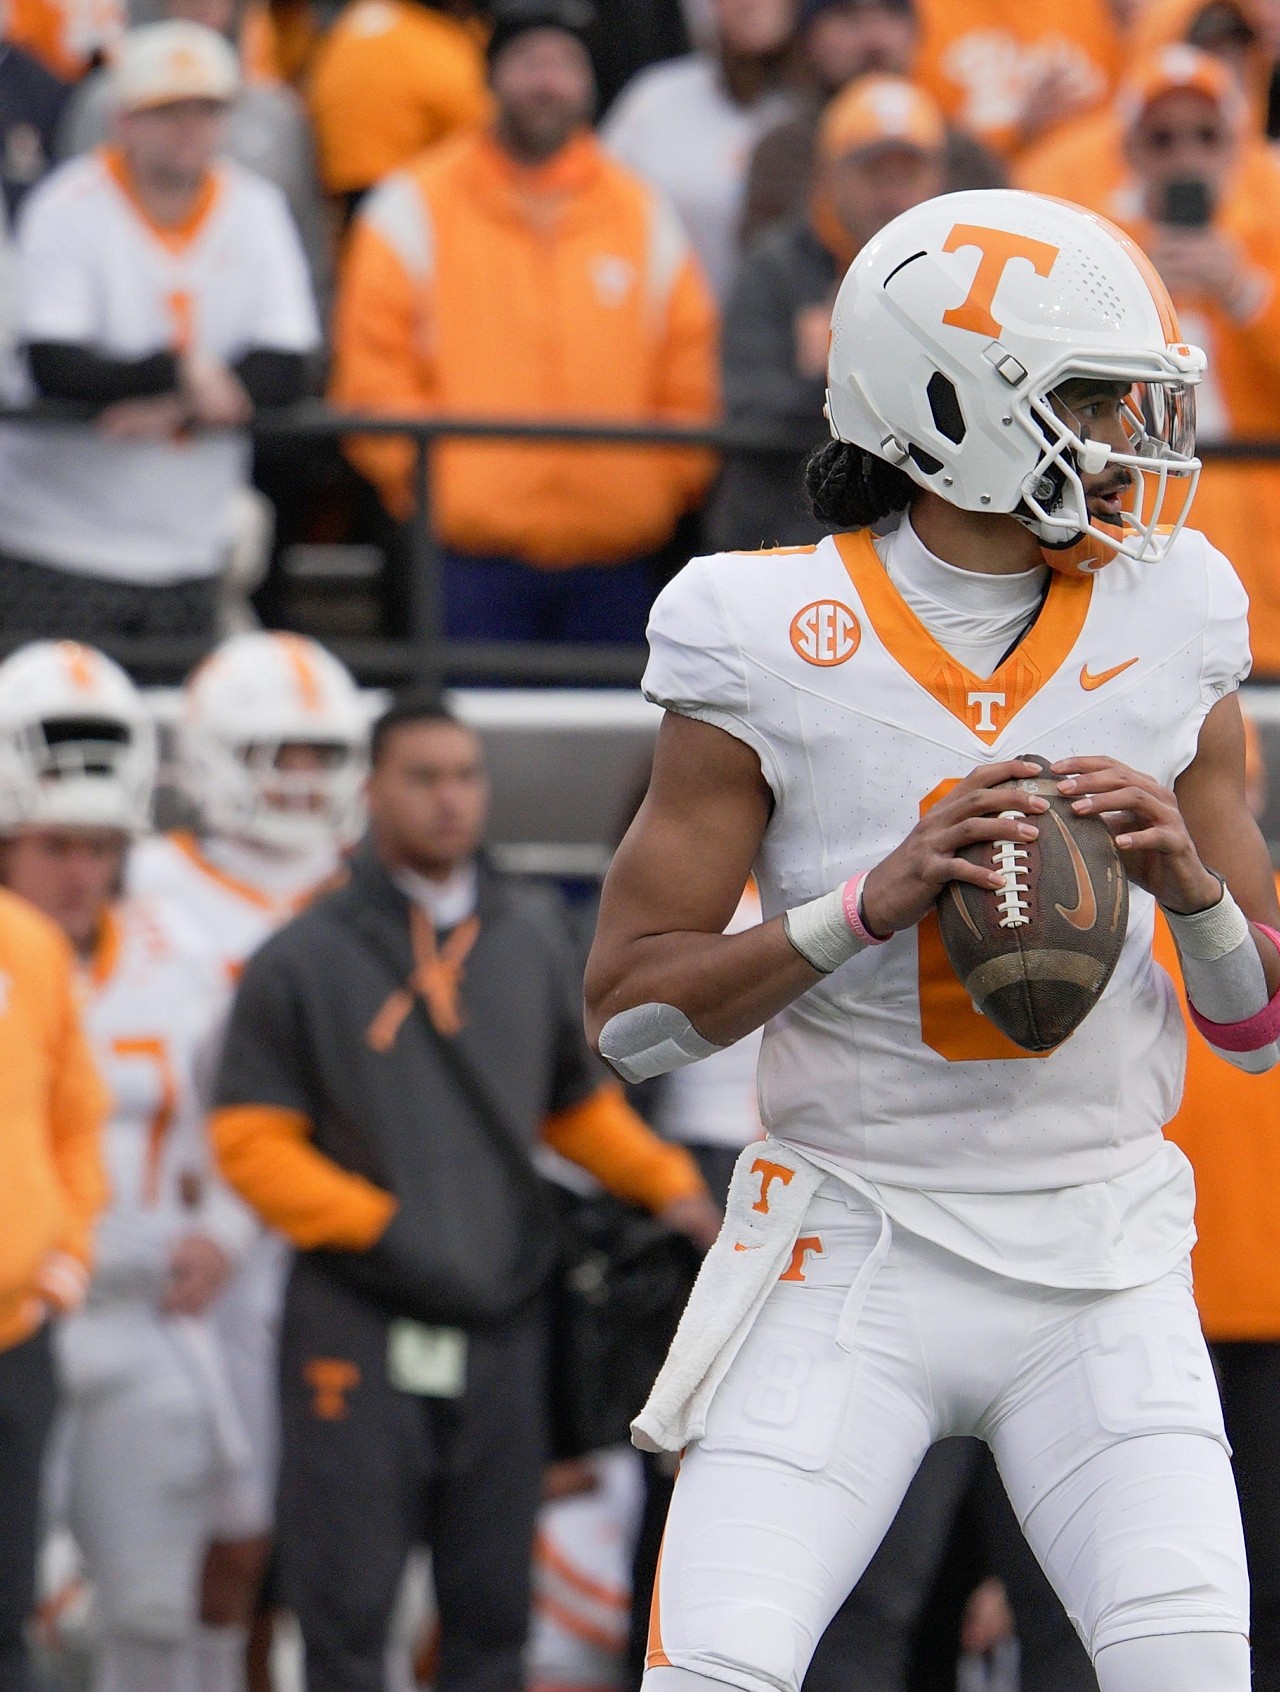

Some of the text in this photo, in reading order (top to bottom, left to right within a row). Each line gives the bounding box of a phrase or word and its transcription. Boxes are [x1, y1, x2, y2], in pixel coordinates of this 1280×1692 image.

[941, 223, 1060, 339] T
[796, 604, 855, 661] SEC
[967, 692, 1006, 731] T
[750, 1158, 796, 1215] T
[778, 1236, 823, 1282] T
